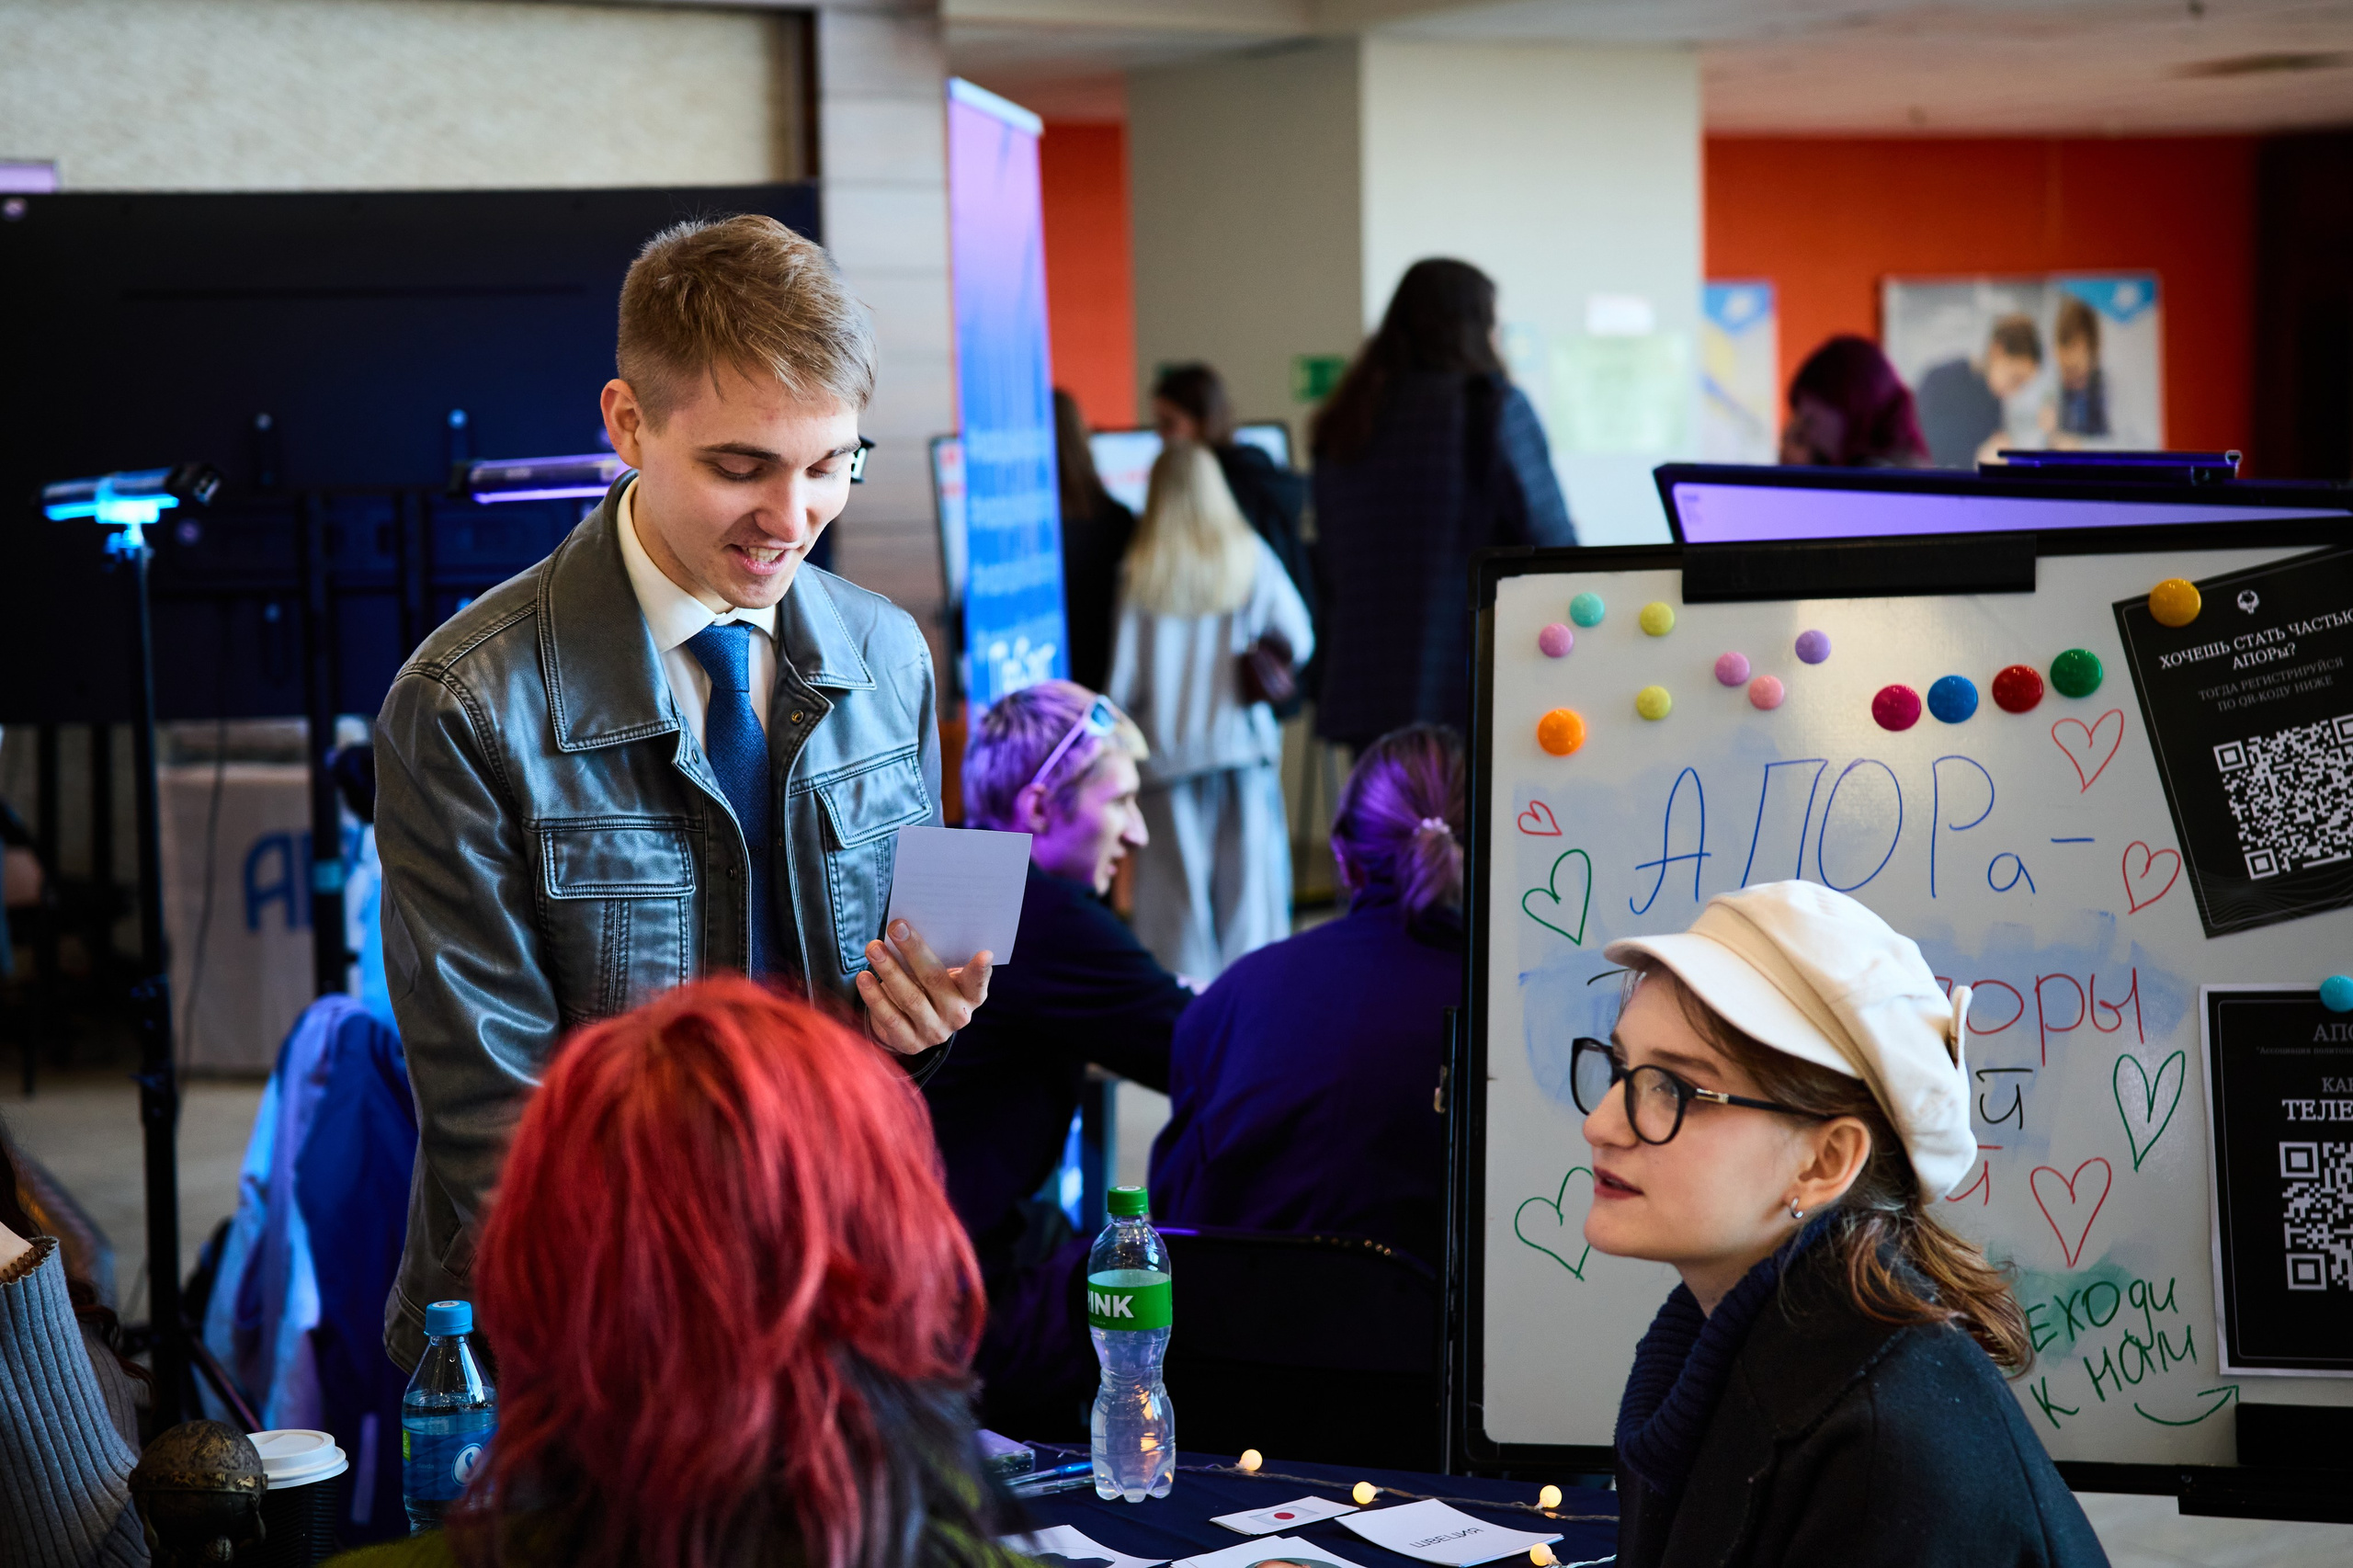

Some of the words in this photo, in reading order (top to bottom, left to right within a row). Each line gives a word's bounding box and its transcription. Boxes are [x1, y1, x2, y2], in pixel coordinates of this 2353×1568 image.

[2159, 640, 2231, 670] ХОЧЕШЬ
[2234, 627, 2286, 652] СТАТЬ
[2233, 642, 2297, 671] АПОРы?
[2199, 683, 2239, 702] ТОГДА
[2241, 656, 2344, 689] РЕГИСТРИРУЙСЯ
[2217, 696, 2236, 712] ПО
[2239, 687, 2290, 706] QR-КОДУ
[2295, 675, 2334, 694] НИЖЕ
[1934, 967, 2145, 1067] оры
[2281, 1099, 2353, 1121] ТЕЛЕ
[1409, 1527, 1484, 1549] ШВЕЦИЯ
